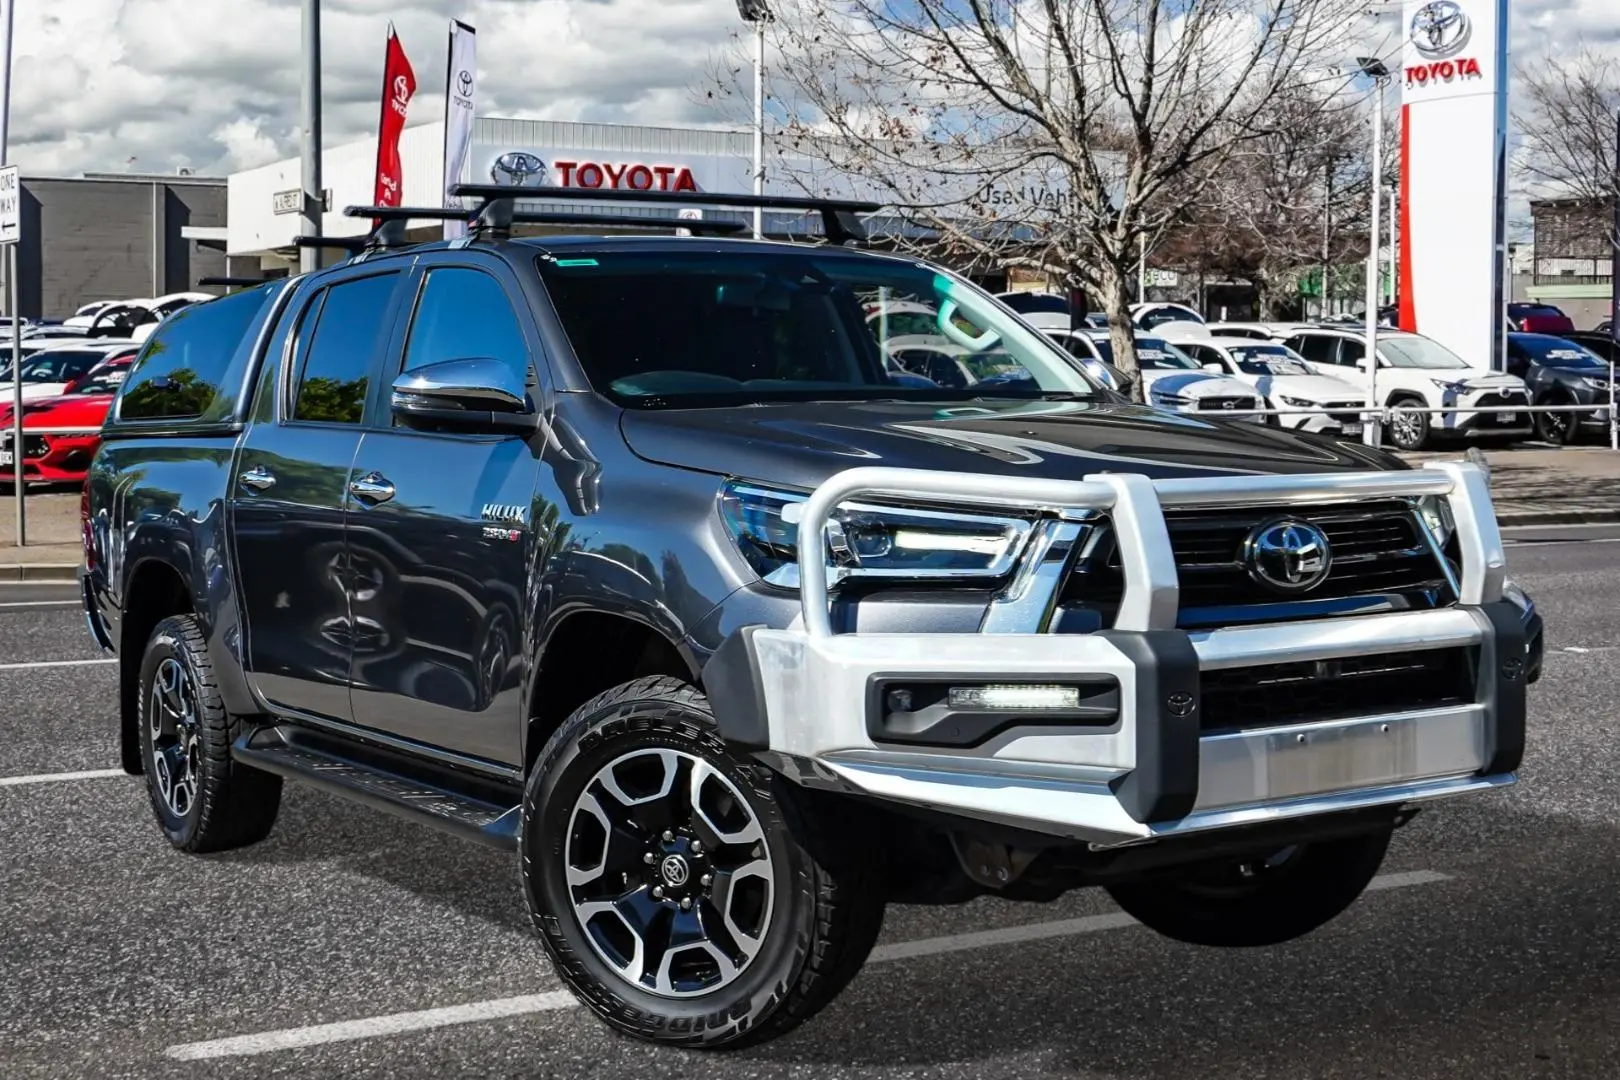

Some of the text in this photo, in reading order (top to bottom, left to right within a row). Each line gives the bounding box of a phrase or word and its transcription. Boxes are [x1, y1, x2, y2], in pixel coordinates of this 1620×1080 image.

[1404, 58, 1481, 84] TOYOTA
[453, 96, 474, 111] TOYOTA
[1, 172, 15, 191] ONE
[554, 161, 698, 193] TOYOTA
[0, 196, 17, 215] WAY
[481, 503, 527, 524] HILUX
